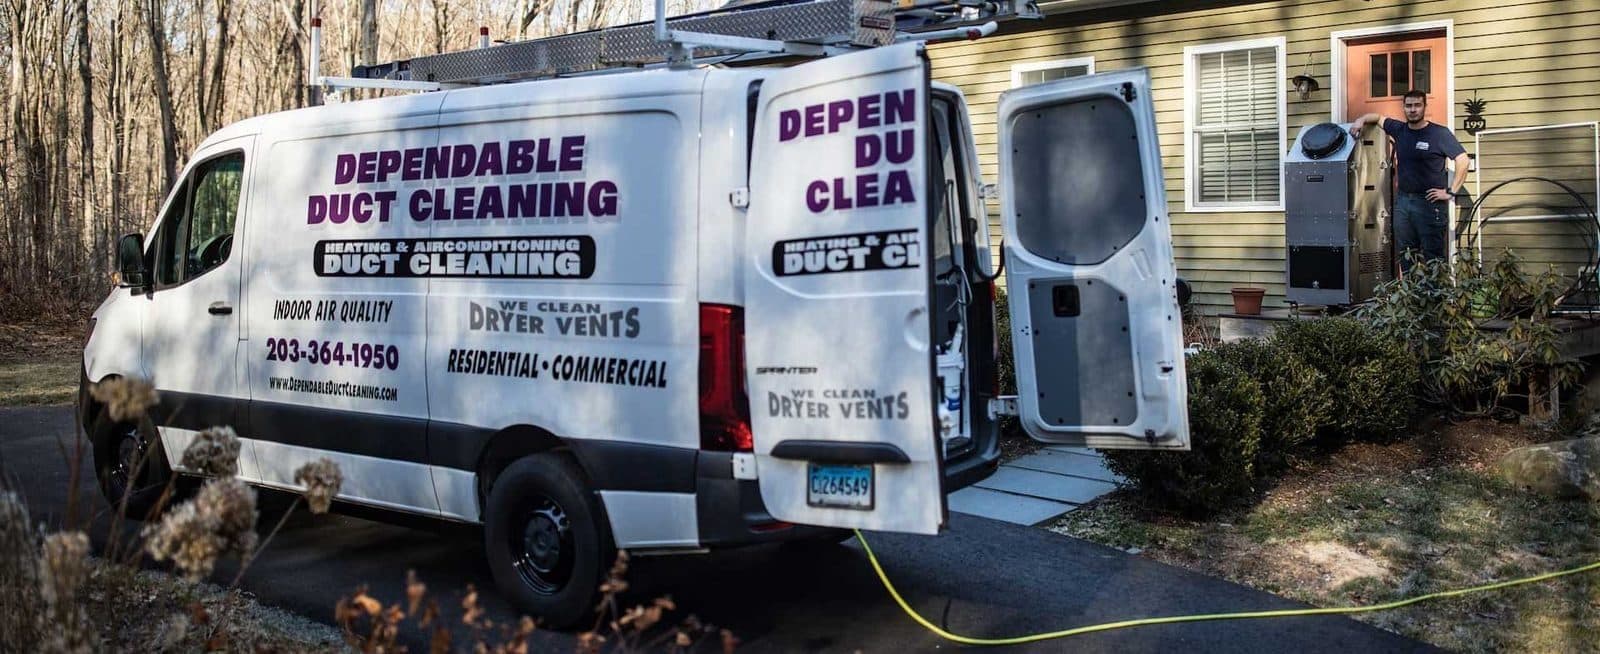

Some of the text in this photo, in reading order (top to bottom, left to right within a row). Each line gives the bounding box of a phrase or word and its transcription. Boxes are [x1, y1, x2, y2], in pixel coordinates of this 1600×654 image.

[1466, 120, 1484, 129] 199
[334, 135, 586, 185] DEPENDABLE
[855, 128, 915, 169] DU
[307, 180, 618, 225] DUCT CLEANING
[806, 170, 916, 213] CLEA
[325, 239, 580, 253] HEATING & AIRCONDITIONING
[784, 237, 860, 253] HEATING
[865, 235, 880, 246] &
[324, 252, 581, 276] DUCT CLEANING
[784, 247, 871, 275] DUCT
[273, 299, 393, 323] INDOOR AIR QUALITY
[469, 301, 641, 339] DRYER VENTS
[500, 300, 601, 314] WE CLEAN
[266, 337, 399, 371] 203-364-1950
[447, 348, 667, 388] RESIDENTIAL COMMERCIAL
[756, 366, 818, 375] SPRINTER
[768, 391, 909, 420] DRYER VENTS
[791, 389, 876, 399] WE CLEAN
